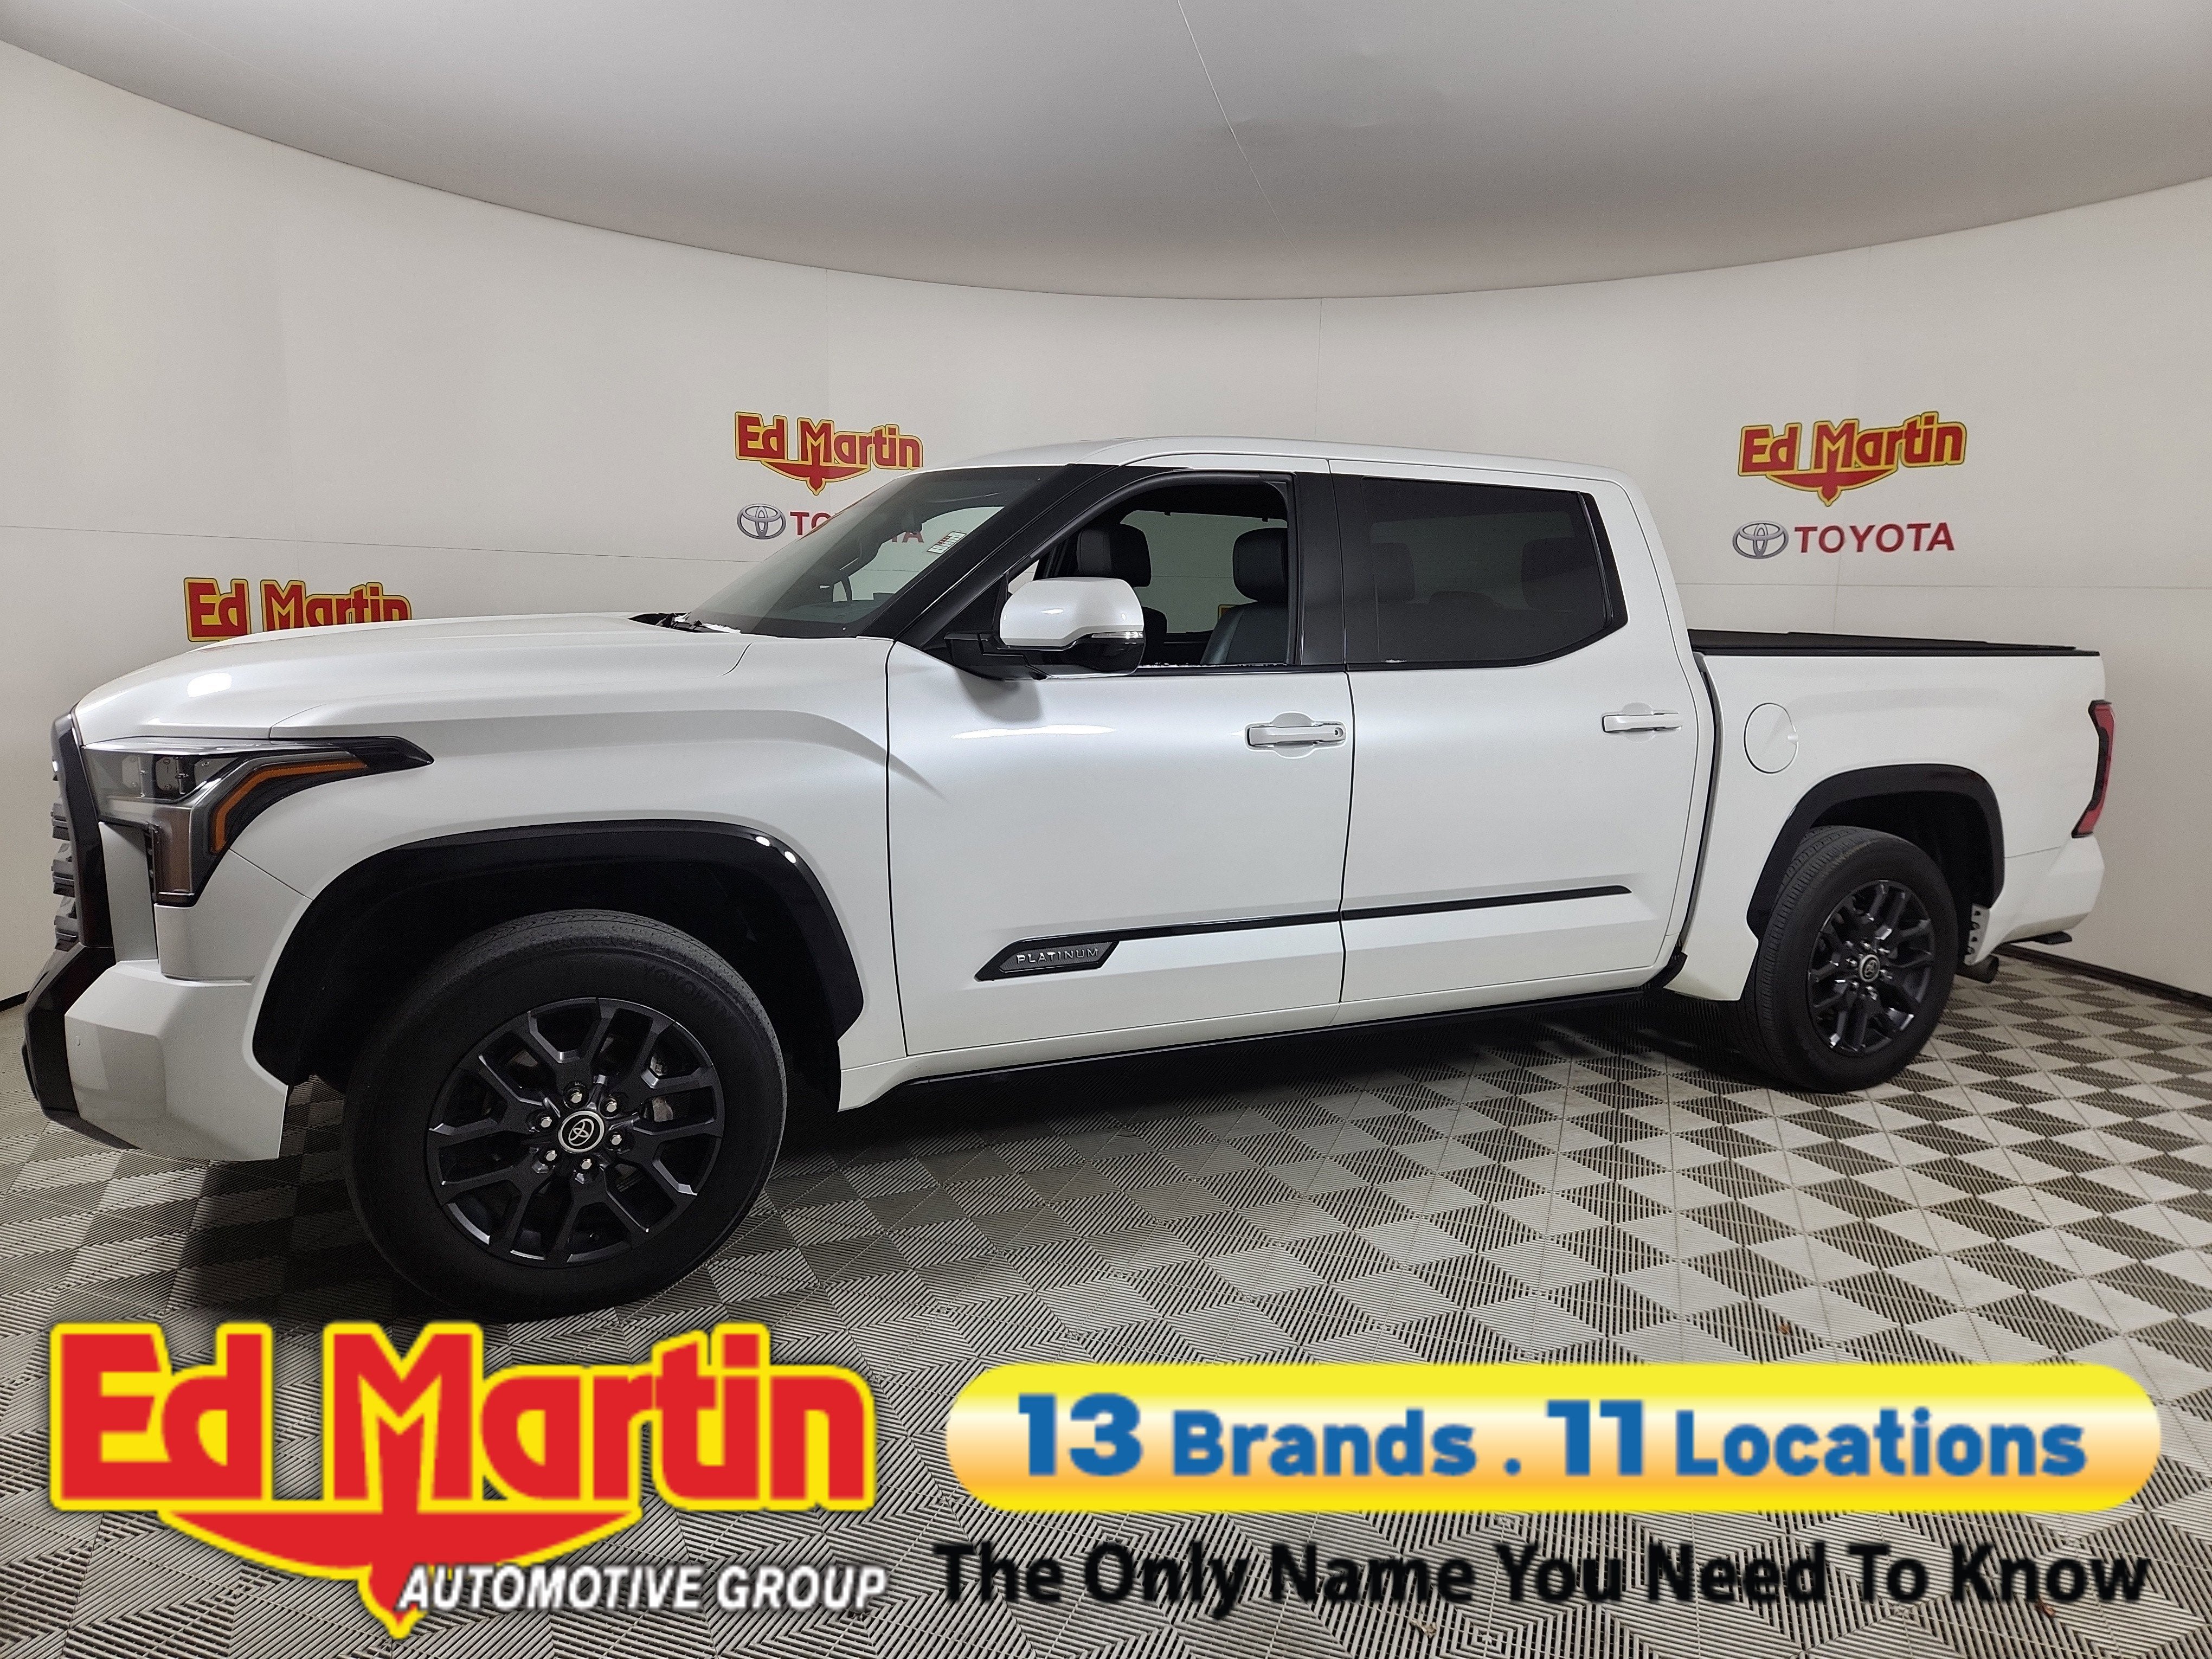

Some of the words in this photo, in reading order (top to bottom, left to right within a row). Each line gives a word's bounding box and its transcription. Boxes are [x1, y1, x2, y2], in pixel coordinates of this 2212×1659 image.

[737, 414, 786, 461] Ed
[799, 419, 922, 468] Martin
[1740, 425, 1799, 474] Ed
[1812, 413, 1965, 470] Martin
[1794, 522, 1955, 554] TOYOTA
[185, 580, 249, 639] Ed
[262, 582, 410, 631] Martin
[1016, 947, 1098, 964] PLATINUM
